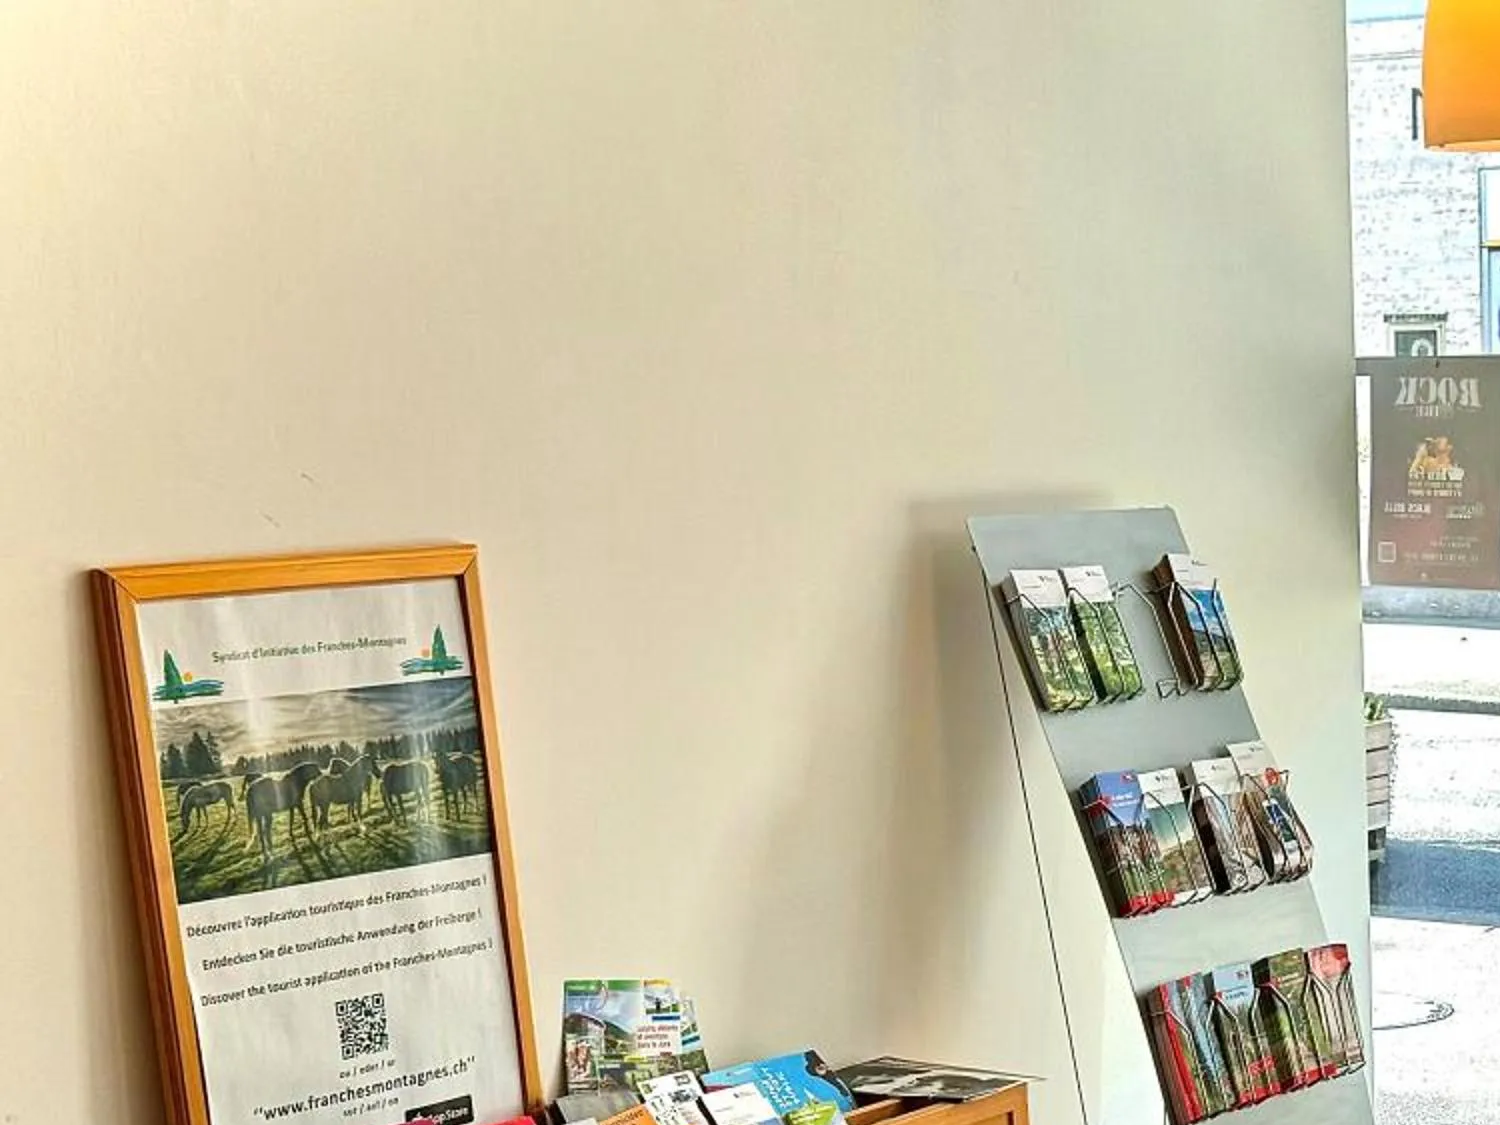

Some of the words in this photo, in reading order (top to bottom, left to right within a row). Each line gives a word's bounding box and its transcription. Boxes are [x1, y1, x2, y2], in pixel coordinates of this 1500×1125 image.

[186, 921, 242, 939] Découvrez
[366, 892, 385, 907] des
[202, 953, 258, 972] Entdecken
[259, 948, 275, 962] Sie
[277, 944, 293, 958] die
[295, 933, 354, 954] touristische
[417, 918, 434, 932] der
[200, 988, 246, 1007] Discover
[247, 984, 266, 999] the
[267, 977, 303, 995] tourist
[304, 966, 360, 990] application
[361, 963, 374, 976] of
[374, 959, 391, 974] the
